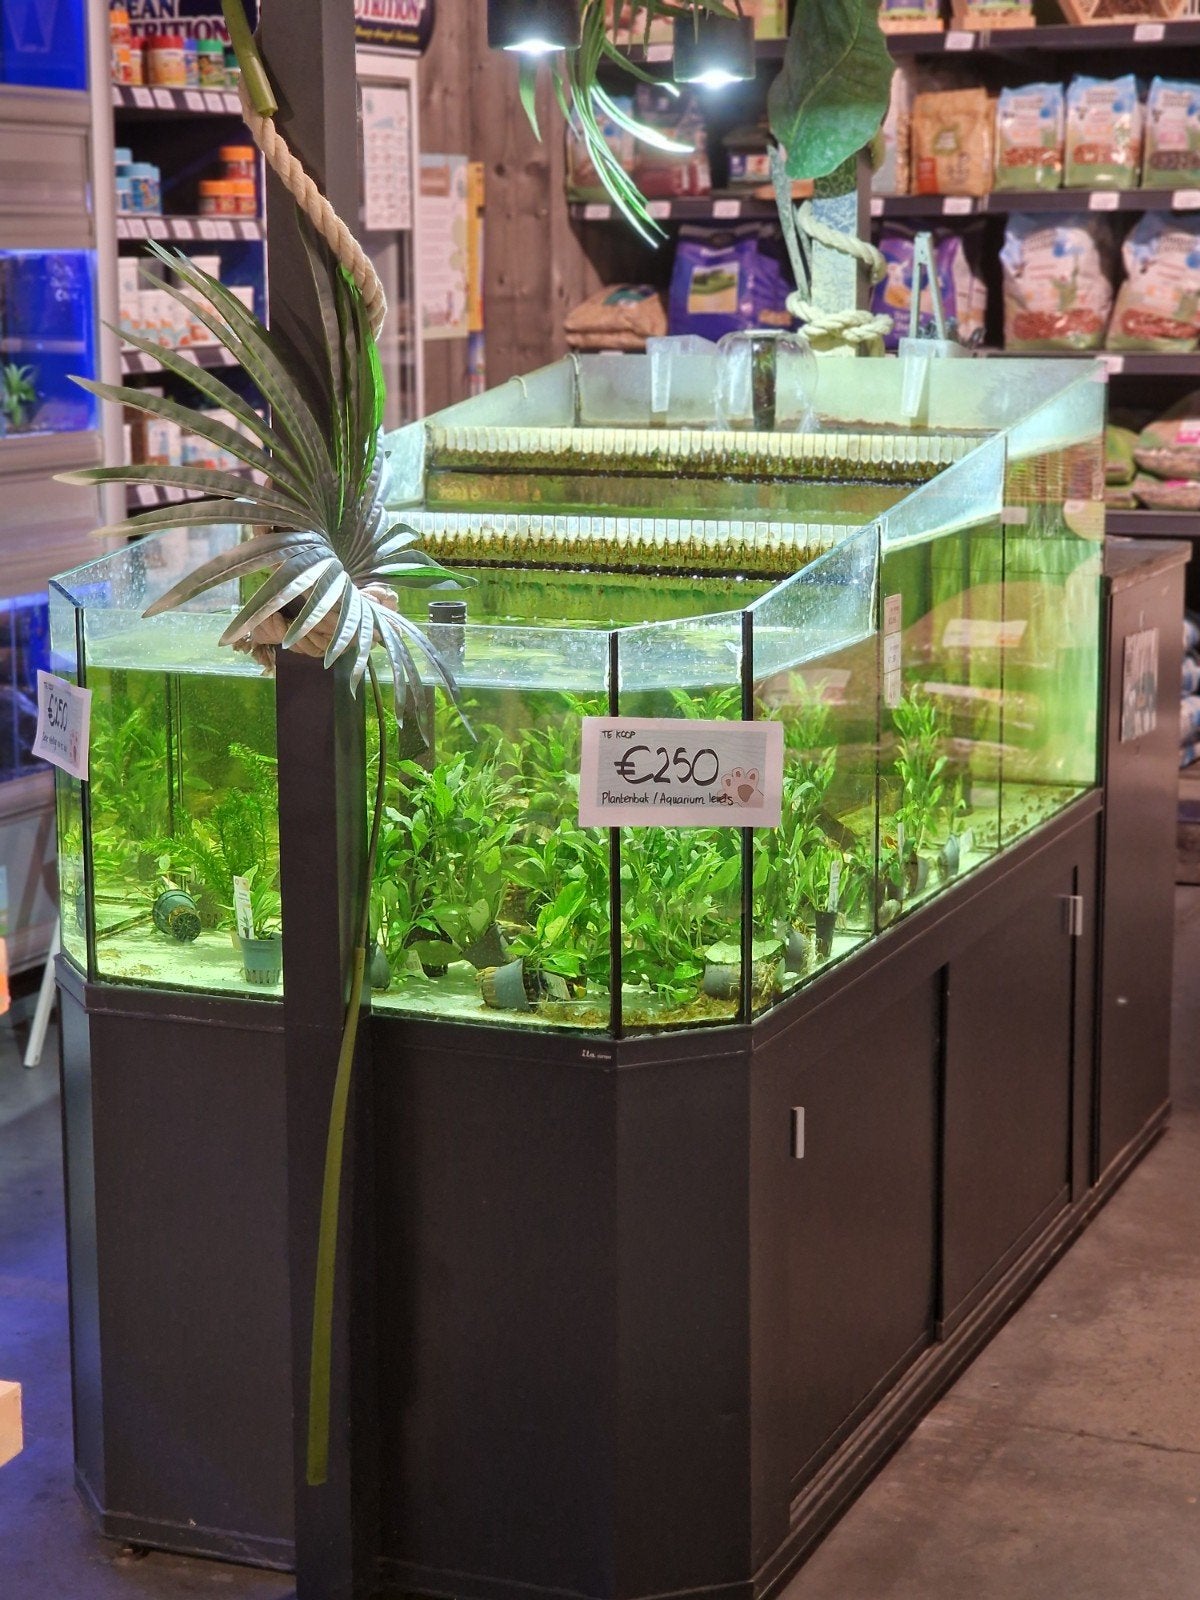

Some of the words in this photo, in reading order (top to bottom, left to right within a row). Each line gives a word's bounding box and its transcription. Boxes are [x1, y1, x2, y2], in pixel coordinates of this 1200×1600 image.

[130, 20, 231, 42] TRITION
[602, 730, 612, 739] TE
[615, 730, 636, 739] KOOP
[614, 745, 719, 786] €250
[601, 791, 649, 805] Plantenbak
[660, 792, 705, 805] Aquarium
